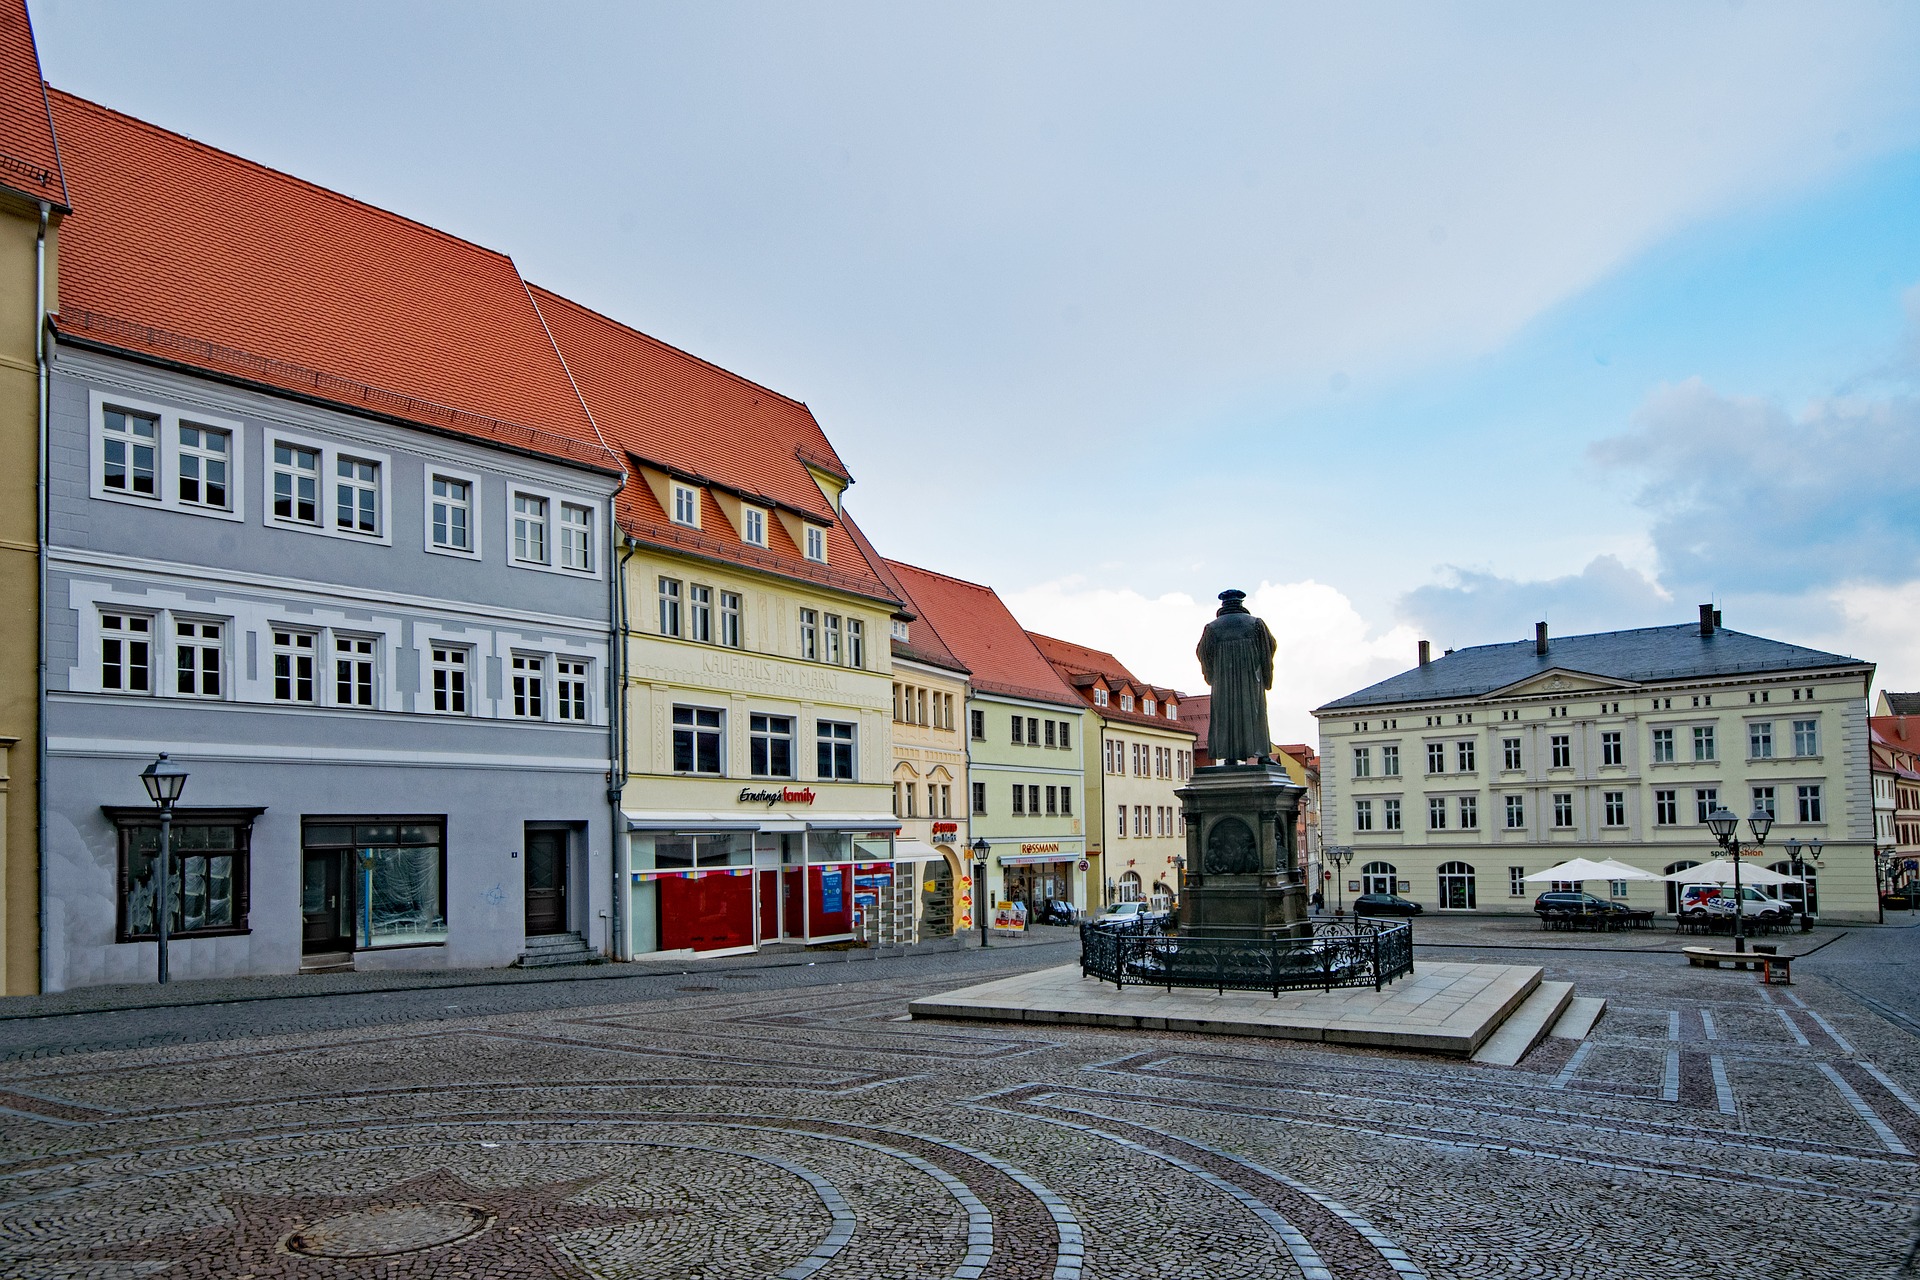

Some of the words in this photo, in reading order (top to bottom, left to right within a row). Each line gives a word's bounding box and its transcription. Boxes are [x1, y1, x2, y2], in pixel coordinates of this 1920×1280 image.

[701, 652, 771, 681] KAUFHAUS
[776, 664, 795, 684] AM
[800, 669, 840, 690] MARKT
[740, 787, 781, 806] Ernsting's
[783, 786, 816, 805] family
[1021, 843, 1059, 854] ROSSMANN
[1707, 898, 1736, 909] CLUB
